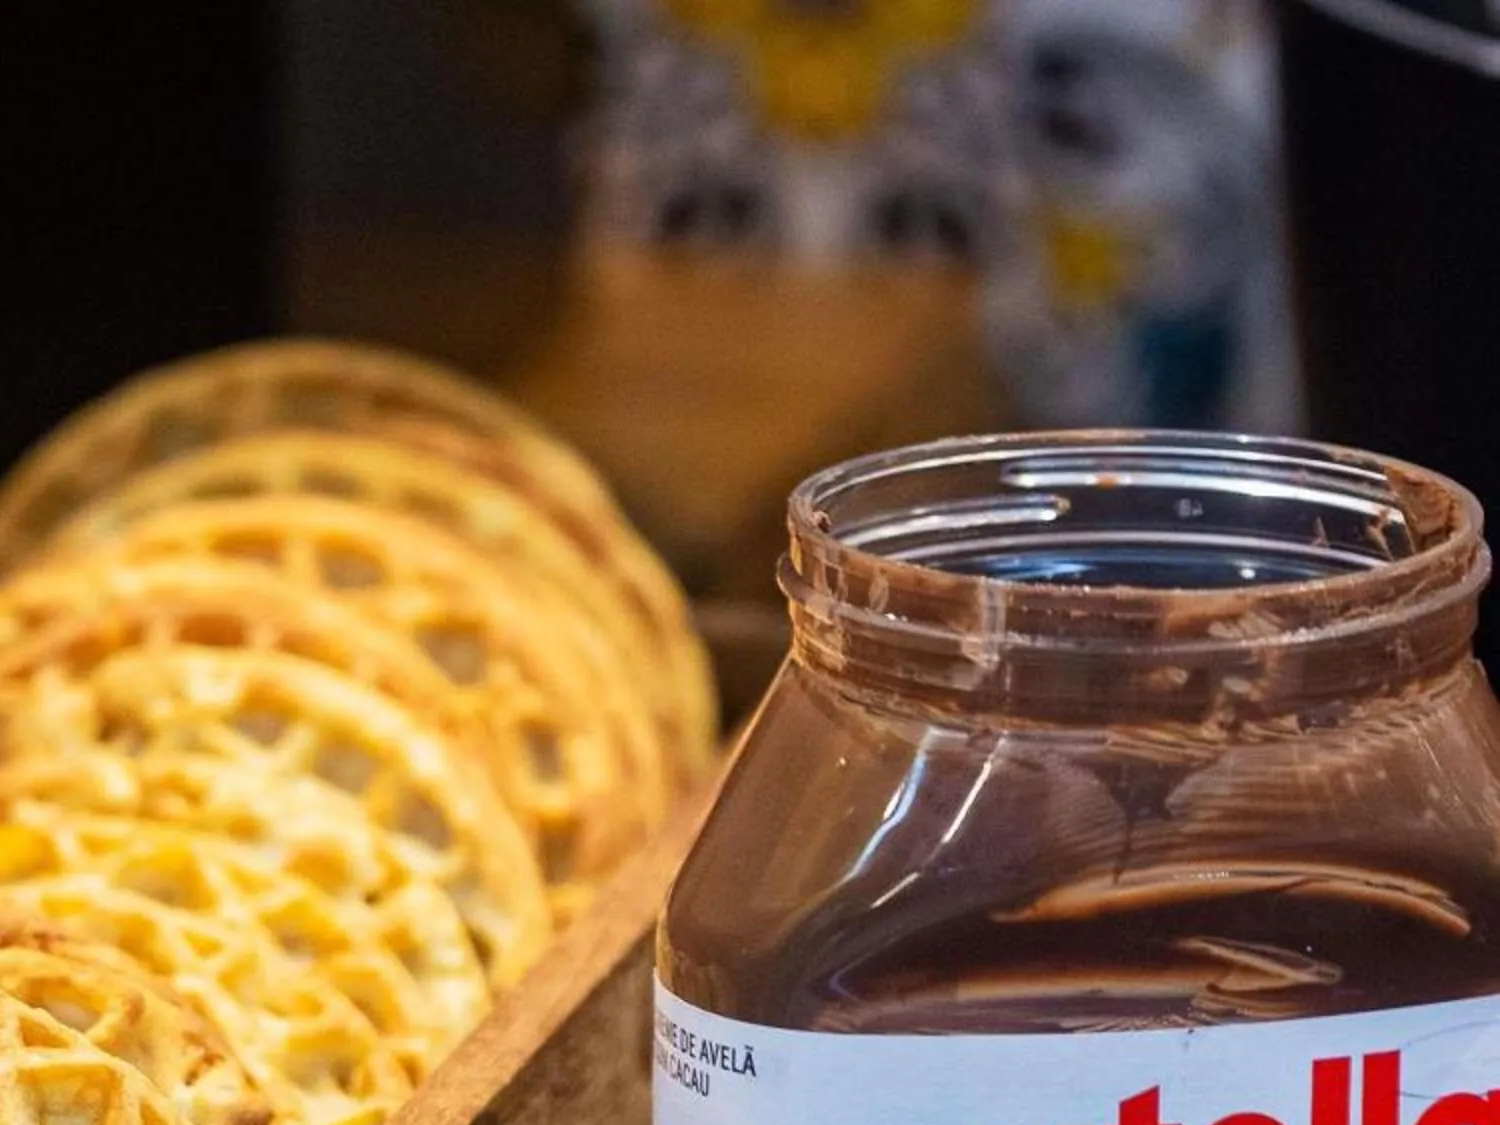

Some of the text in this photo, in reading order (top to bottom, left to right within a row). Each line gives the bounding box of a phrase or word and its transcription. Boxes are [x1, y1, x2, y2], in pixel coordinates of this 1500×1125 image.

[670, 1051, 710, 1097] CACAU
[680, 1027, 697, 1058] DE
[700, 1039, 757, 1077] AVELÃ
